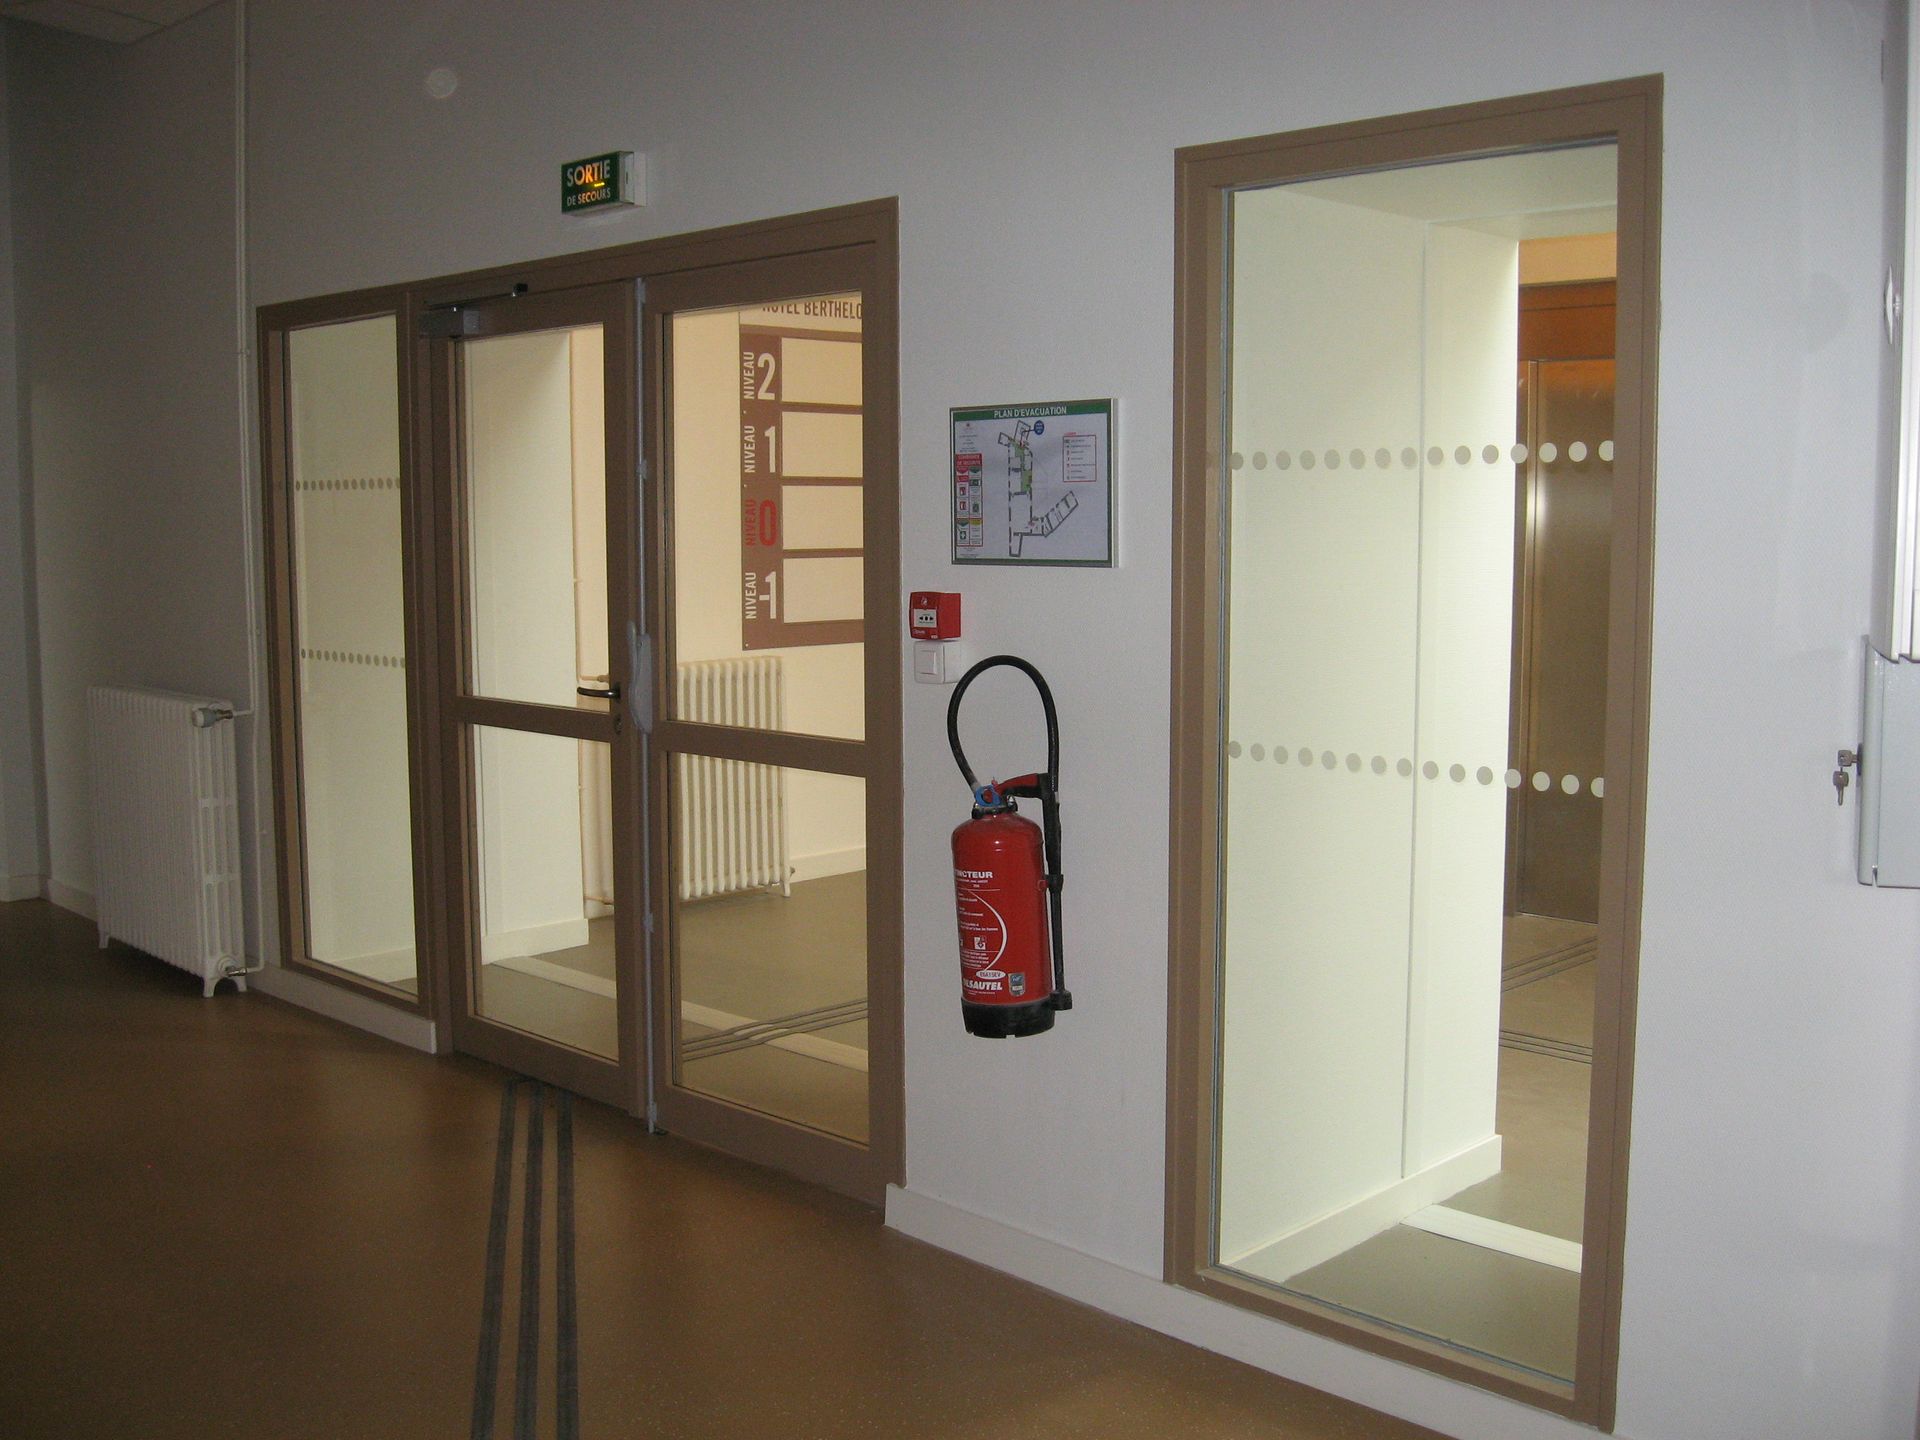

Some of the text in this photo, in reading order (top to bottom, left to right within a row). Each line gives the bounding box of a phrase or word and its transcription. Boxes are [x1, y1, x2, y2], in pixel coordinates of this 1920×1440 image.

[567, 160, 610, 187] SORTIE
[567, 188, 611, 206] DE SECOURS
[743, 352, 776, 400] NIVEAU 2
[994, 410, 1012, 418] PLAN
[744, 425, 776, 473] NIVEAU 1
[744, 500, 777, 546] NIVEAU 0
[745, 571, 777, 619] NIVEAU -1
